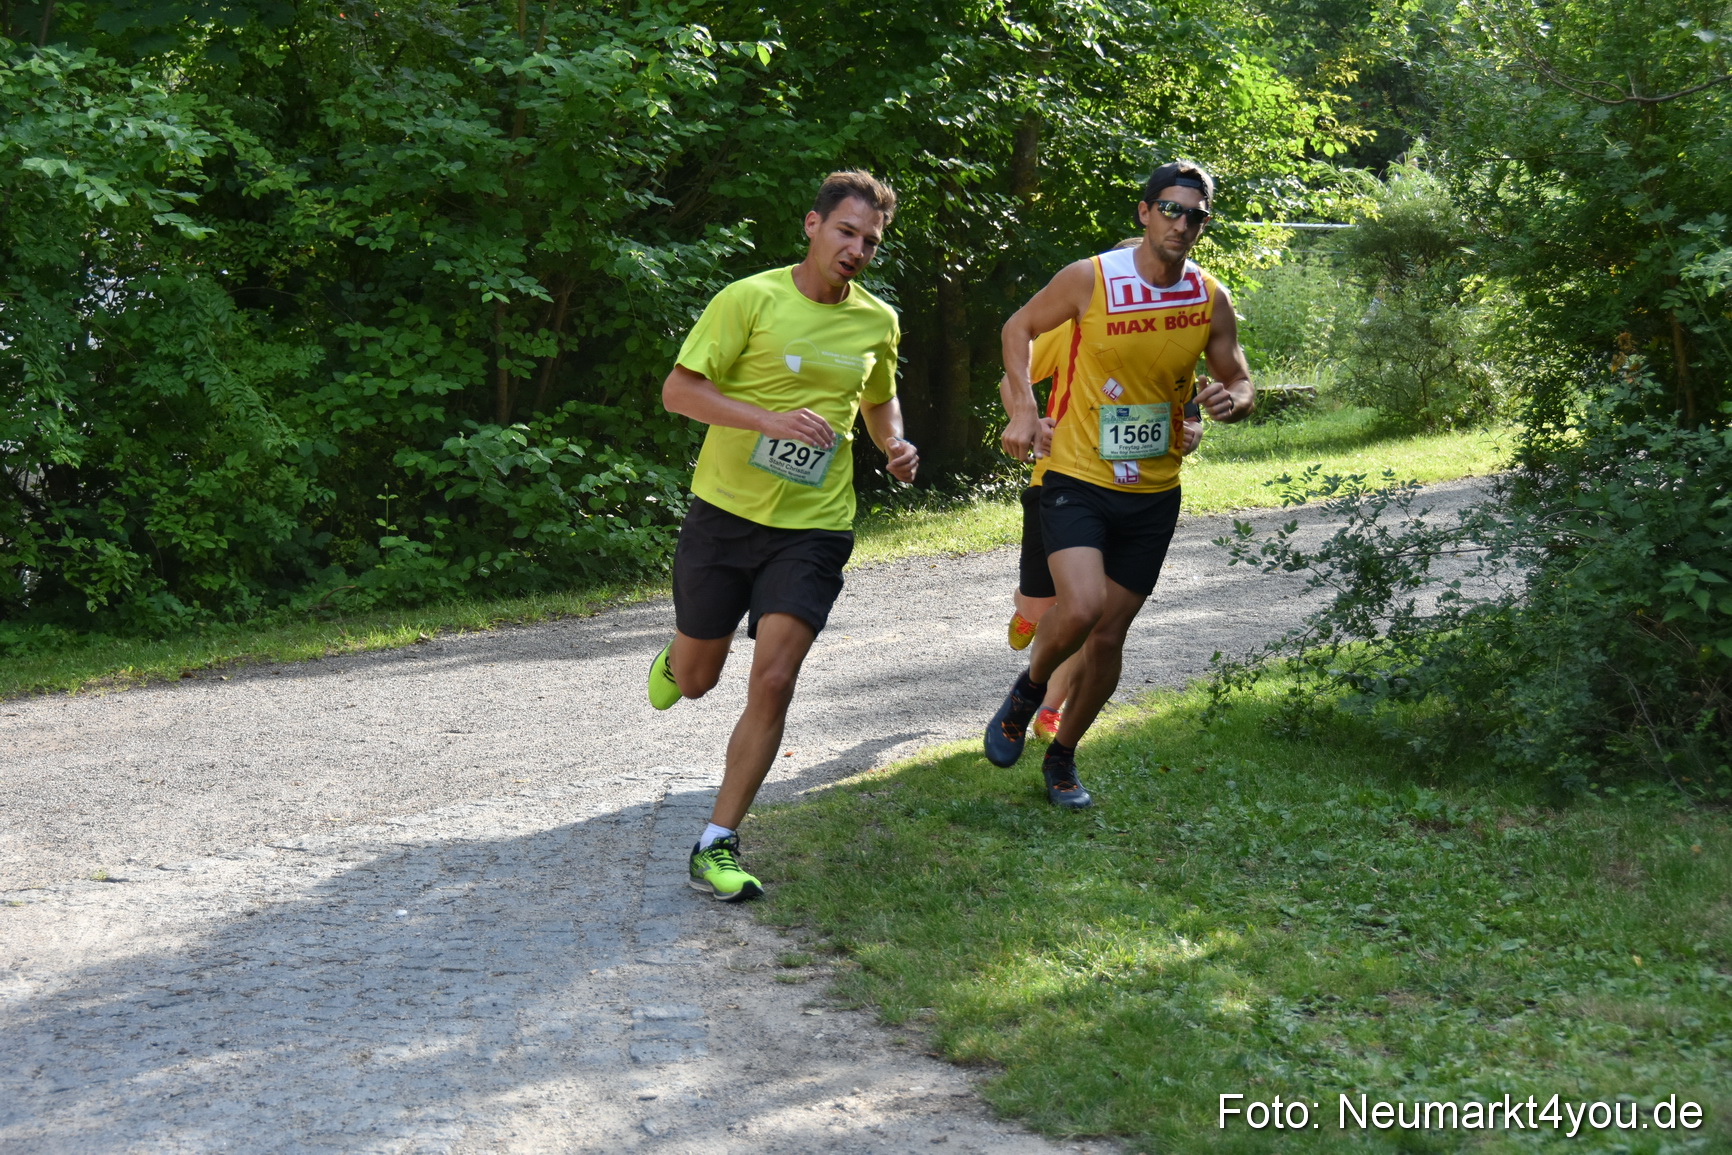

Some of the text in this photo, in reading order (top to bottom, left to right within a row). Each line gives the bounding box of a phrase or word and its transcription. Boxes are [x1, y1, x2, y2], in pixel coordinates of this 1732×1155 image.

[1107, 311, 1211, 336] MAX BÖGL
[1109, 423, 1162, 444] 1566
[768, 439, 825, 470] 1297
[769, 457, 811, 475] Stahl Christian
